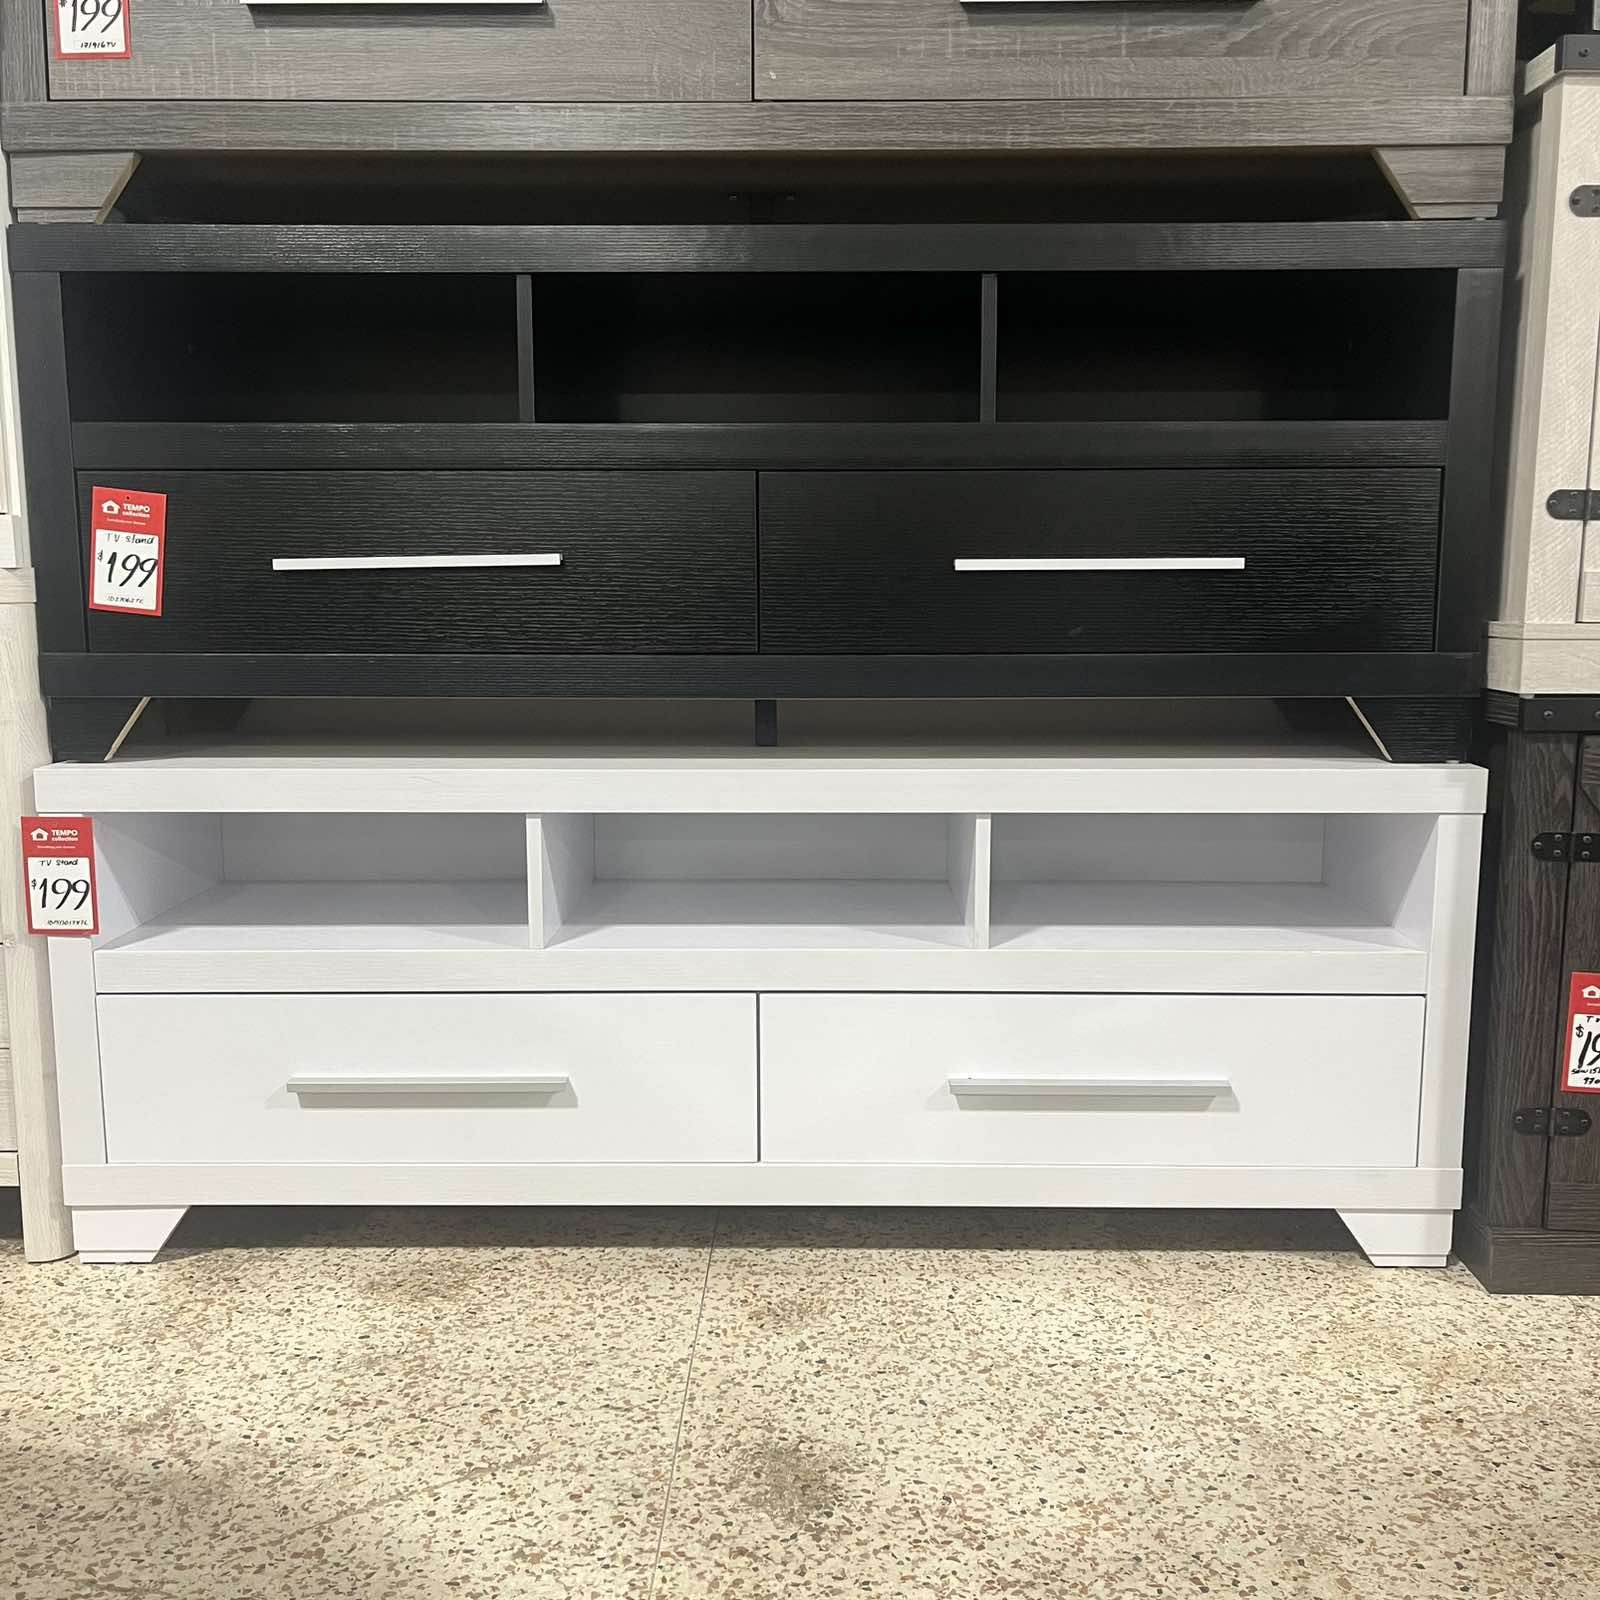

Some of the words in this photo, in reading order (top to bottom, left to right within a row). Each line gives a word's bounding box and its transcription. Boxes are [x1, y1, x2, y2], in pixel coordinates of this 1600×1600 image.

[123, 503, 151, 513] TEMPO
[105, 533, 121, 543] TV
[51, 829, 78, 837] TEMPO
[40, 859, 52, 867] TV
